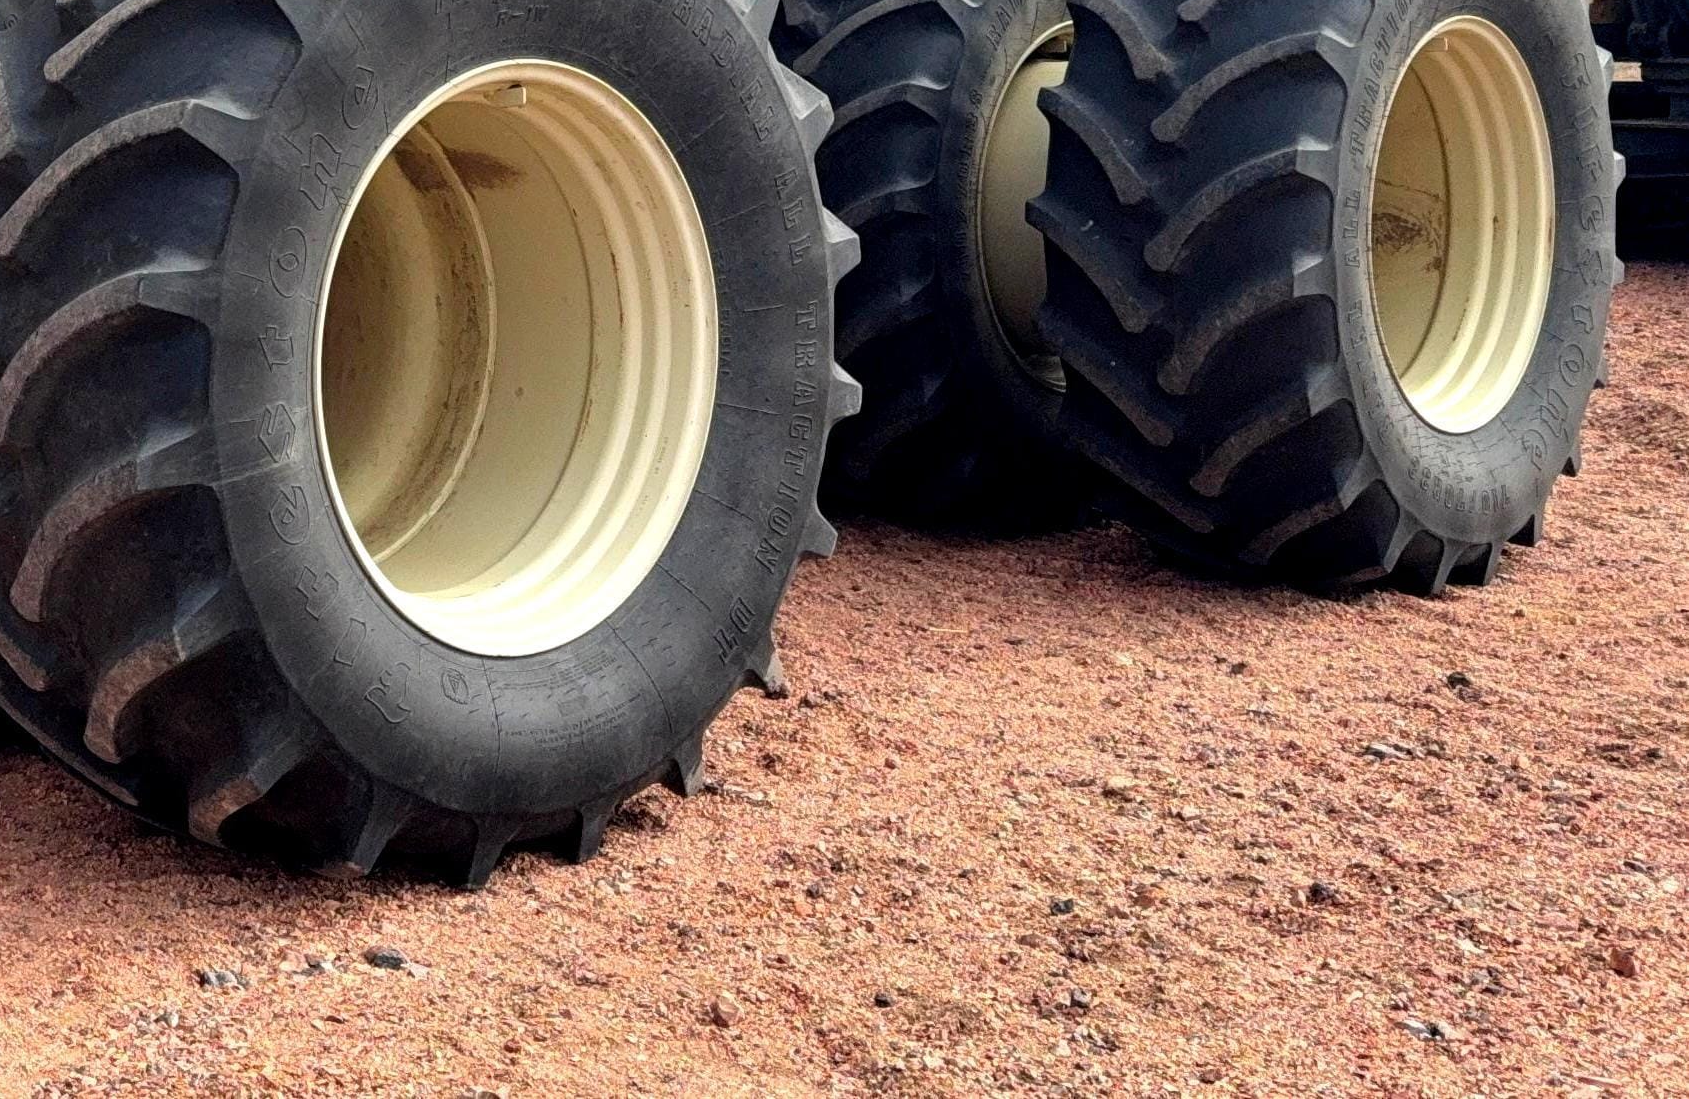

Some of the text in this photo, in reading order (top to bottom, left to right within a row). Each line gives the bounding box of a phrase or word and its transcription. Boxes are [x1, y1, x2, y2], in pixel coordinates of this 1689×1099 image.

[774, 168, 811, 267] ALL
[1342, 189, 1361, 268] ALL
[257, 65, 412, 723] Firestone
[755, 301, 818, 575] TRACTION
[713, 596, 757, 666] DT
